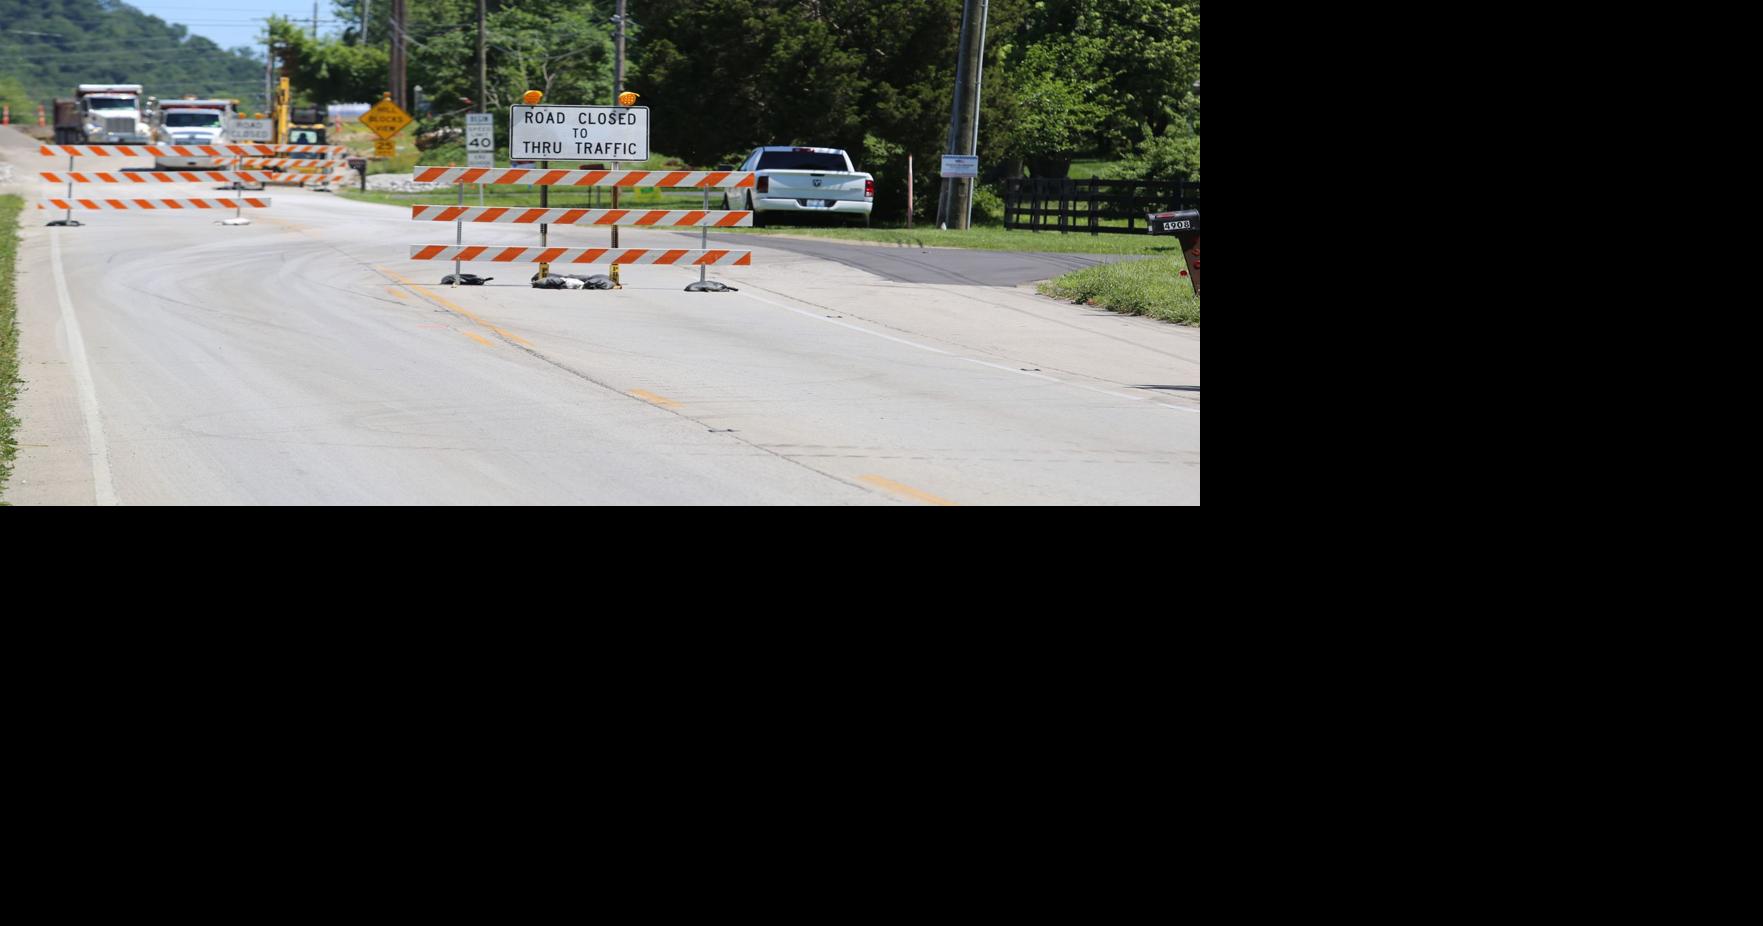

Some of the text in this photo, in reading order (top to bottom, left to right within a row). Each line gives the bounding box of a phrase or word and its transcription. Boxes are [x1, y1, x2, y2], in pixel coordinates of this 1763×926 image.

[524, 111, 637, 126] ROAD CLOSED
[235, 121, 264, 129] ROAD
[231, 130, 270, 138] CLOSED
[572, 127, 588, 139] TO
[469, 137, 492, 148] 40
[522, 141, 637, 155] THRU TRAFFIC
[1164, 221, 1190, 230] 4908
